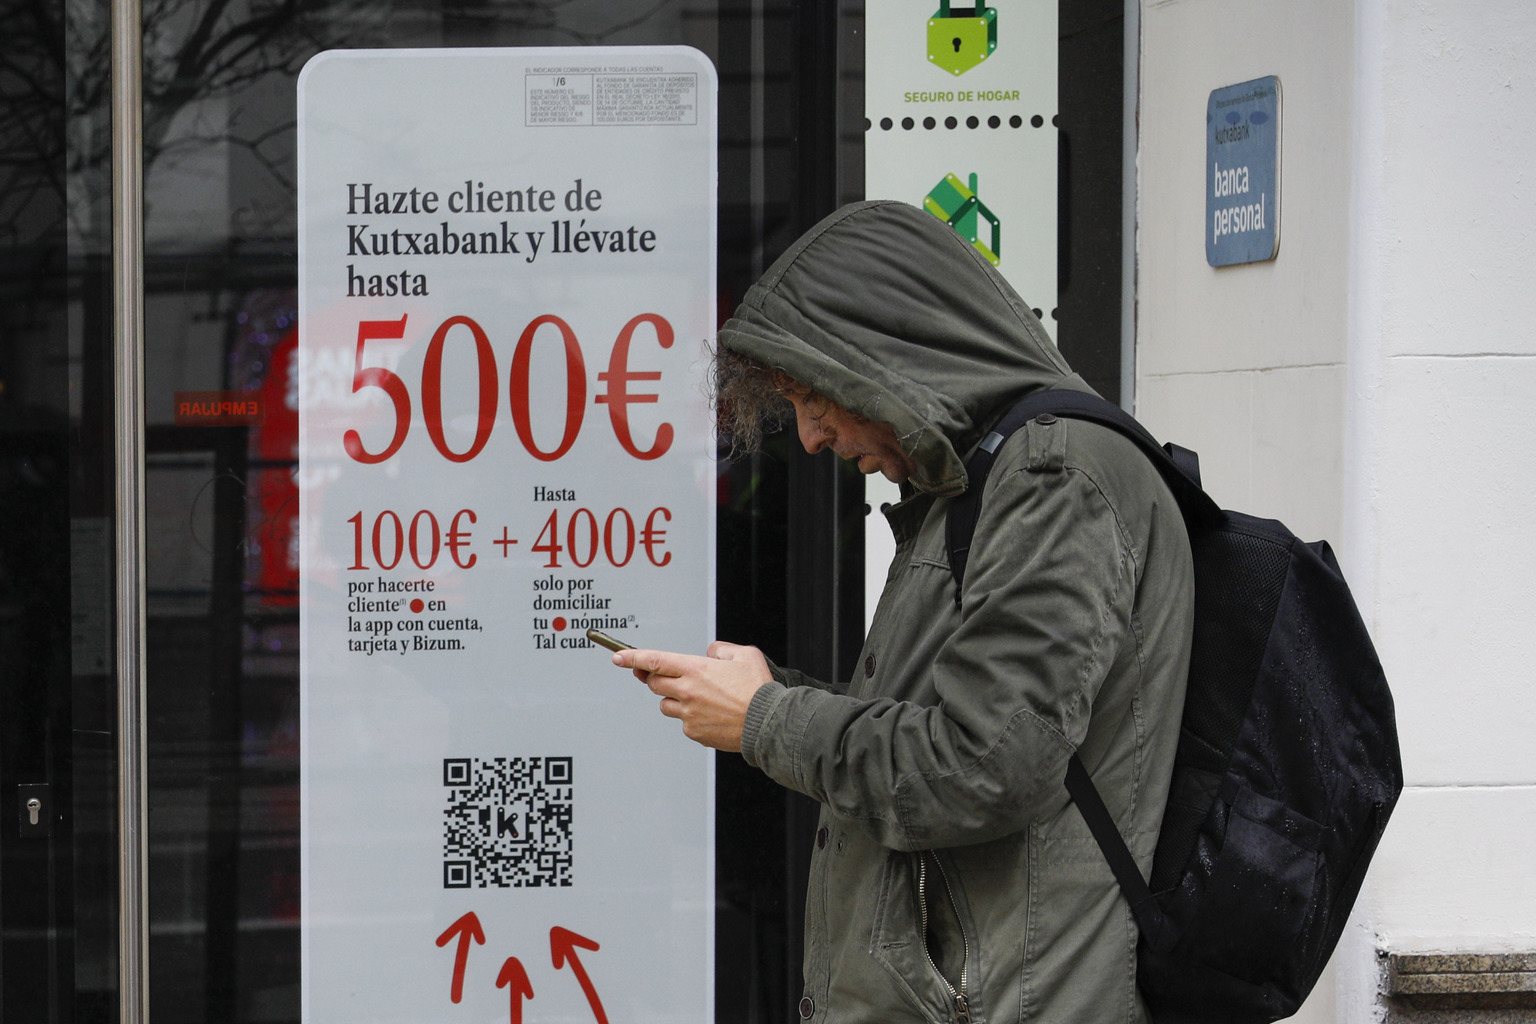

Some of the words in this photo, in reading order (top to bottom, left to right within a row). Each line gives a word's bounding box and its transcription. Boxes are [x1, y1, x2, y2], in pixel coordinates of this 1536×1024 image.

[904, 91, 954, 102] SEGURO
[958, 91, 973, 102] DE
[977, 89, 1020, 101] HOGAR
[1215, 119, 1250, 146] kutxabank
[1214, 162, 1249, 198] banca
[347, 183, 439, 214] Hazte
[448, 179, 555, 213] cliente
[564, 178, 602, 212] de
[1213, 192, 1265, 245] personal
[347, 221, 519, 255] Kutxabank
[526, 232, 544, 263] y
[552, 218, 656, 253] llévate
[347, 264, 429, 297] hasta
[344, 313, 674, 464] 500€
[534, 486, 576, 501] Hasta
[347, 509, 477, 571] 100€
[493, 526, 518, 558] +
[531, 507, 672, 568] 400€
[348, 582, 374, 598] por
[378, 576, 435, 592] hacerte
[533, 574, 564, 591] solo
[568, 579, 594, 594] por
[428, 600, 446, 611] en
[533, 594, 611, 610] domiciliar
[348, 616, 361, 632] la
[365, 621, 393, 636] app
[397, 620, 424, 631] con
[428, 618, 483, 632] cuenta,
[533, 617, 548, 630] tu
[348, 635, 397, 656] tarjeta
[400, 640, 409, 655] y
[413, 635, 465, 650] Bizum.
[533, 634, 556, 649] Tal
[560, 636, 596, 649] cual.
